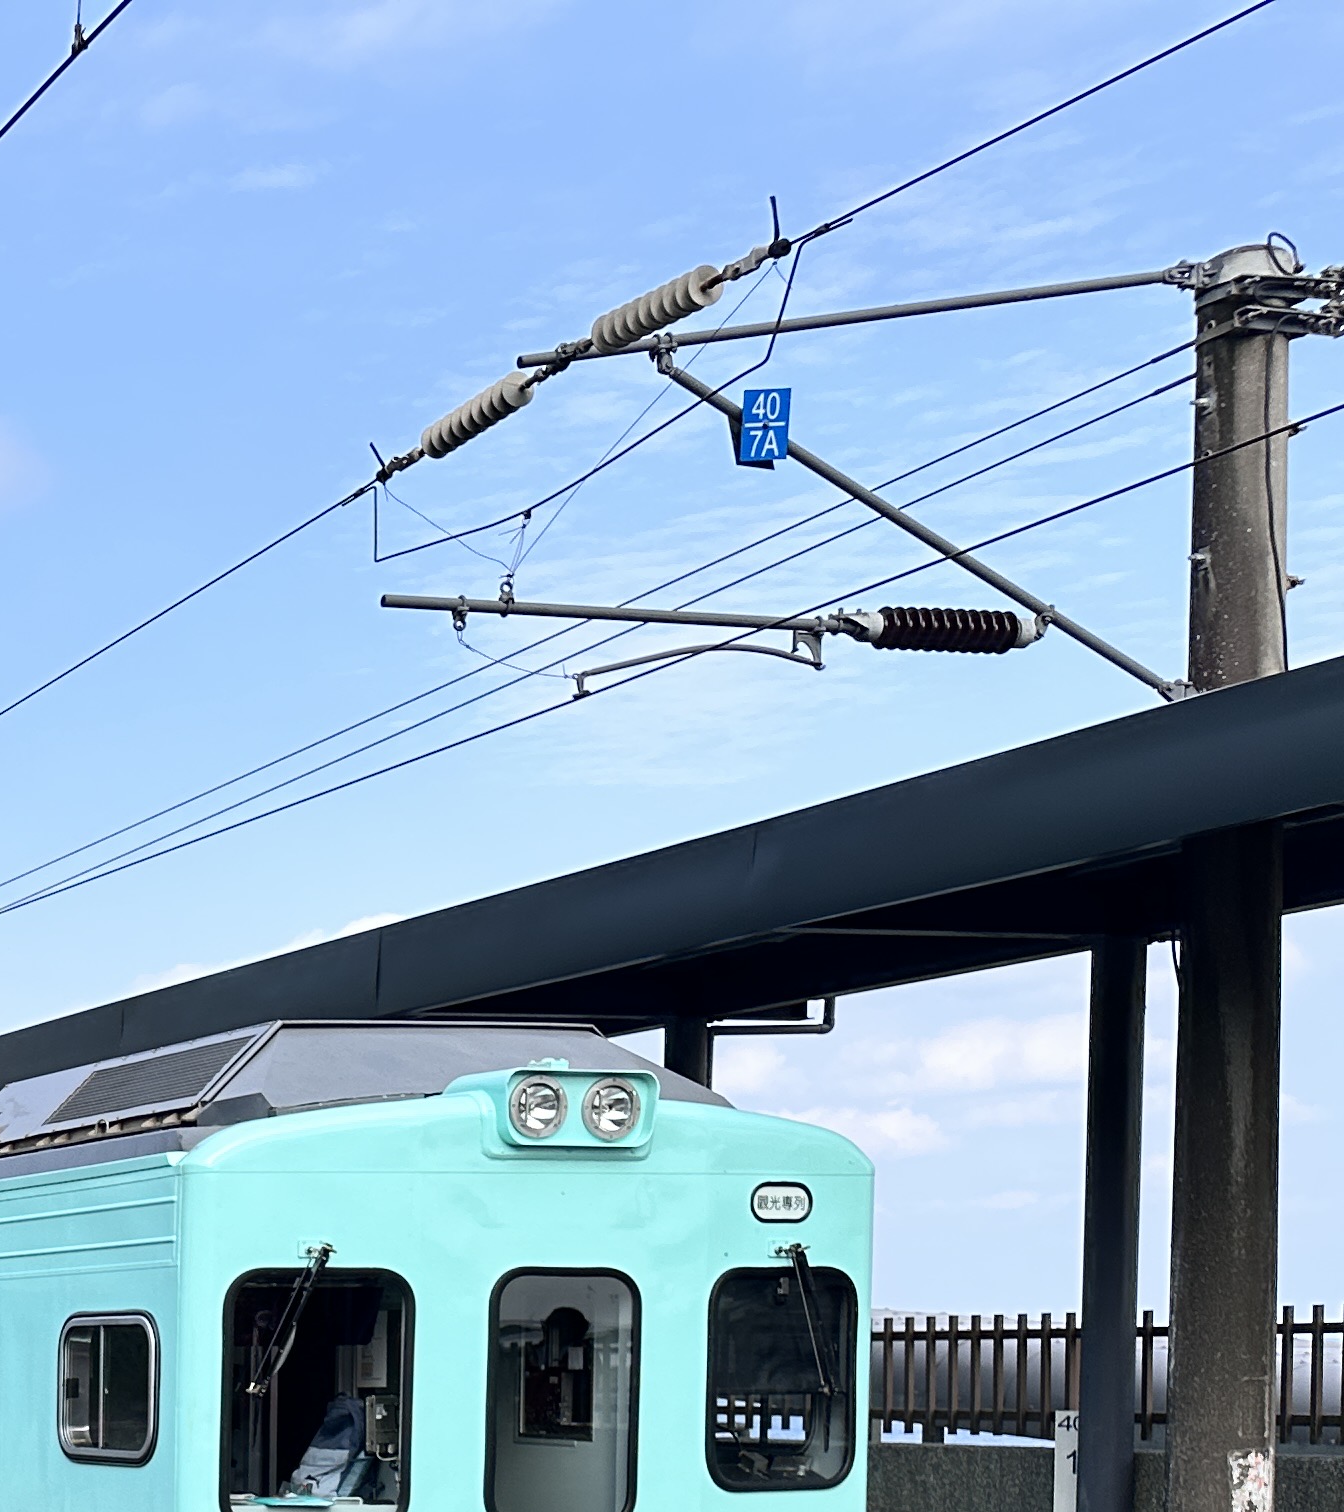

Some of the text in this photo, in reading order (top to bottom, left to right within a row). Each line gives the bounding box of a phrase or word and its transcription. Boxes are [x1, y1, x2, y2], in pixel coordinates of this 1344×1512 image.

[752, 392, 781, 420] 40
[749, 429, 779, 457] 7A
[1066, 1449, 1077, 1475] 1
